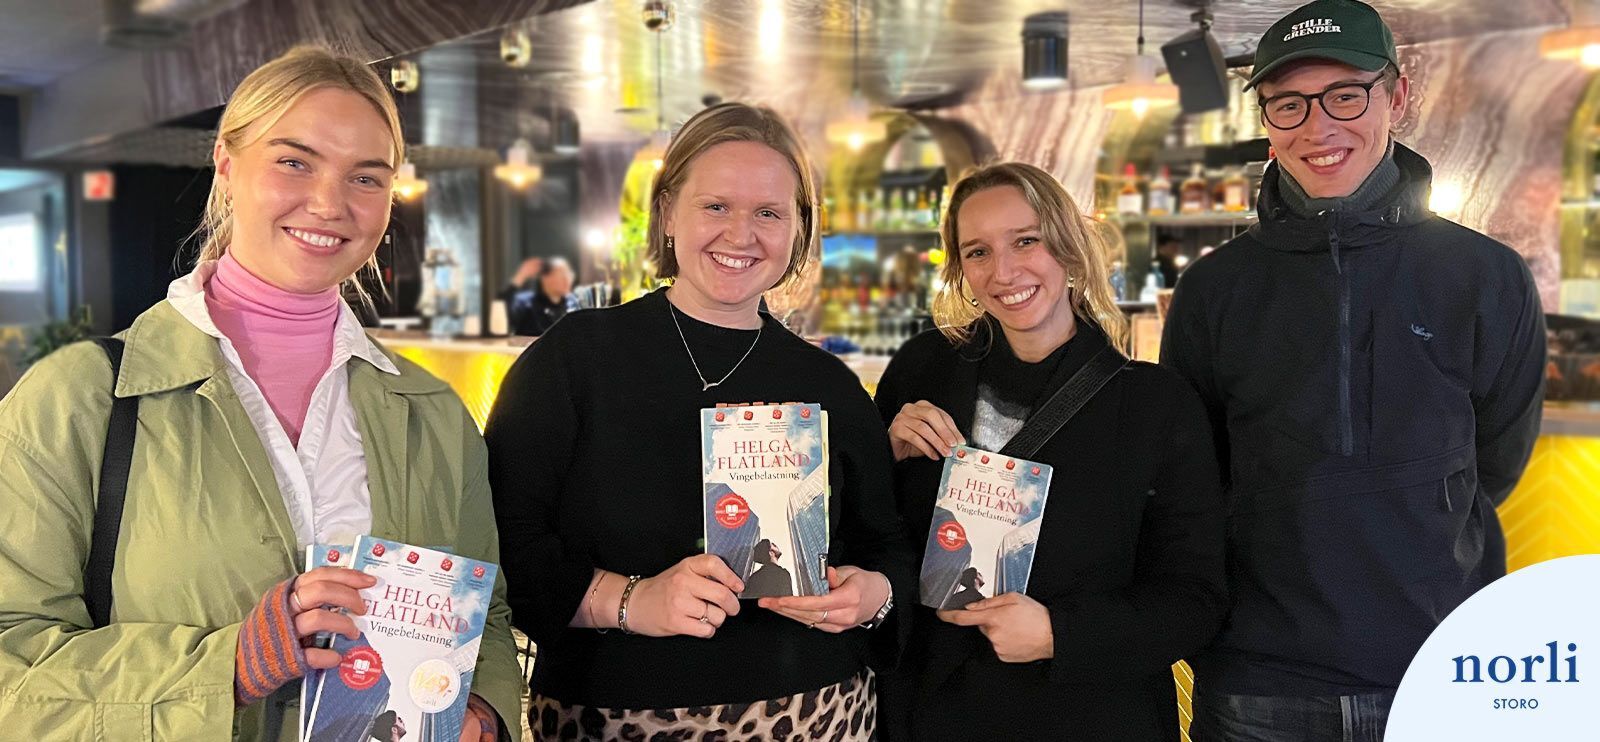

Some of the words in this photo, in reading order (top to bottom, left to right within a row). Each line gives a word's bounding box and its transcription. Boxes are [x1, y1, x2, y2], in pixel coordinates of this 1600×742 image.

[1283, 25, 1341, 41] GRENDER
[1291, 18, 1333, 31] STILLE
[734, 438, 792, 454] HELGA
[717, 453, 811, 470] FLATLAND
[729, 470, 801, 483] Vingebelastning
[965, 478, 1016, 500] HELGA
[949, 487, 1031, 516] FLATLAND
[384, 583, 452, 612] HELGA
[370, 620, 453, 648] Vingebelastning
